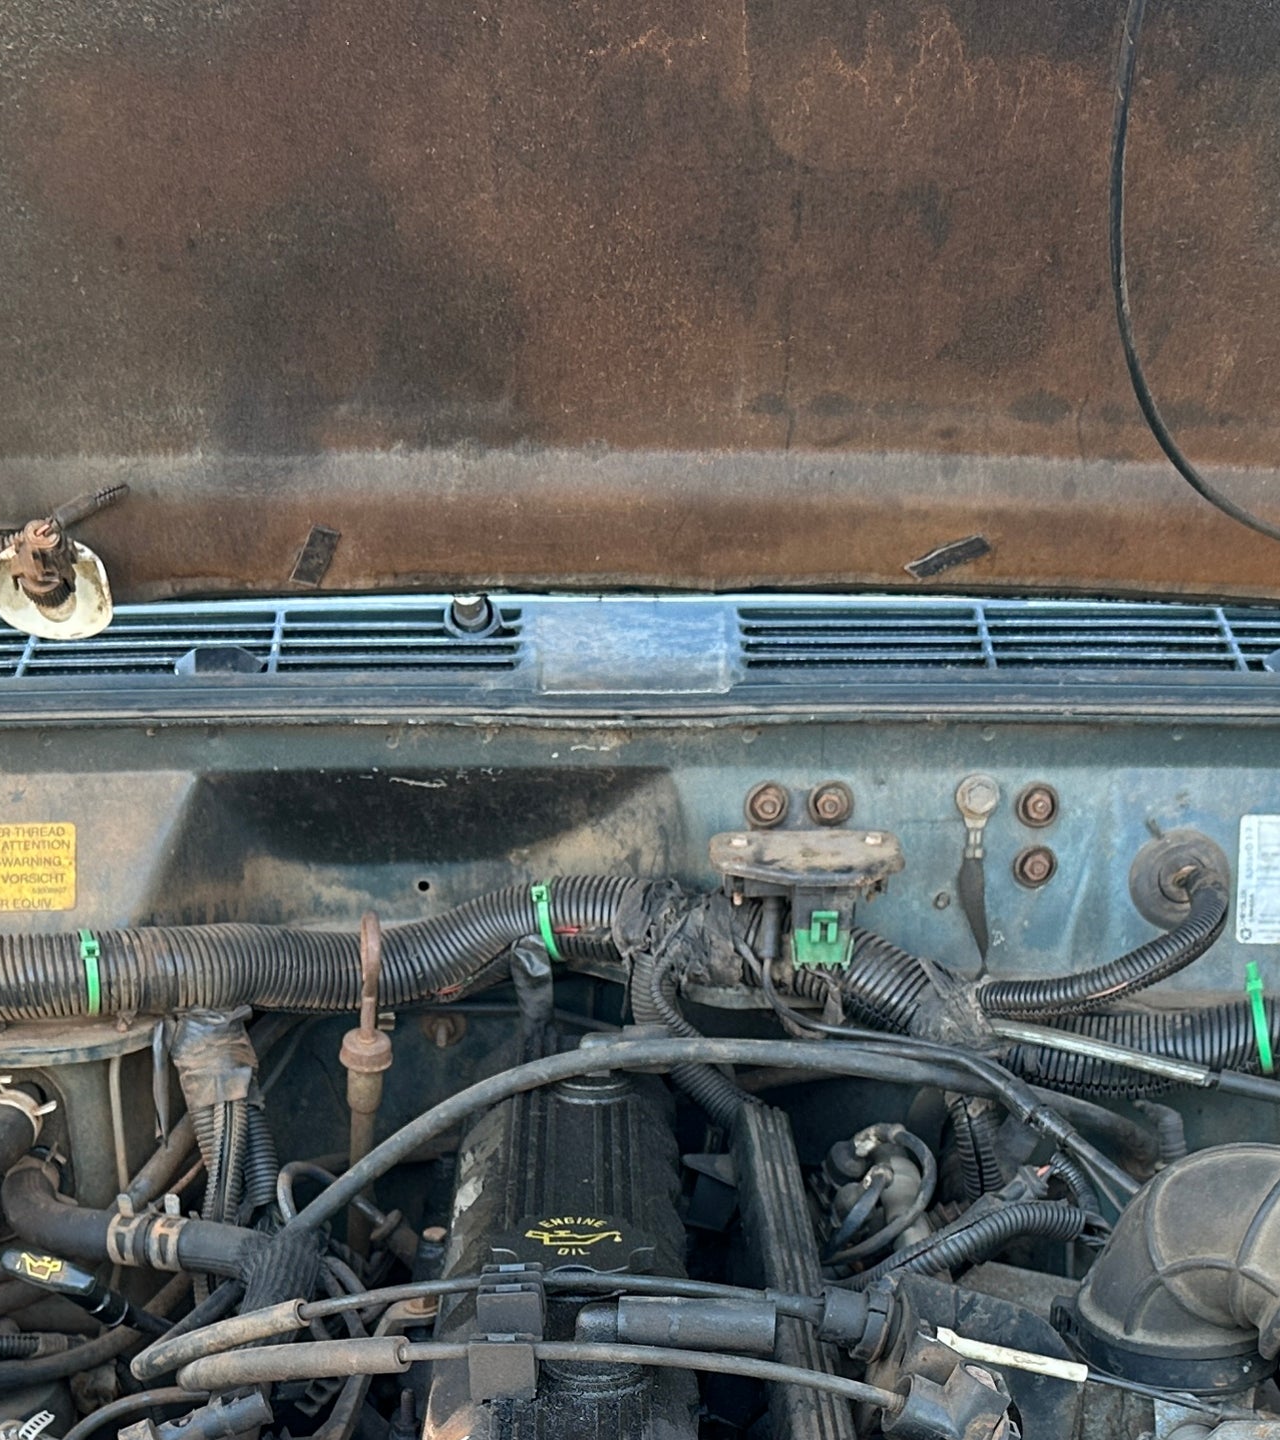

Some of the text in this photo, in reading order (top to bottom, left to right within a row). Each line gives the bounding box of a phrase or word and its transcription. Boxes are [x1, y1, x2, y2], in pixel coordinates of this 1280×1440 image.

[1, 839, 70, 851] ATTENTION
[1, 856, 62, 867] WARNING
[1, 873, 65, 885] VORSICHT
[538, 1216, 608, 1229] ENGINE
[557, 1248, 591, 1256] OIL
